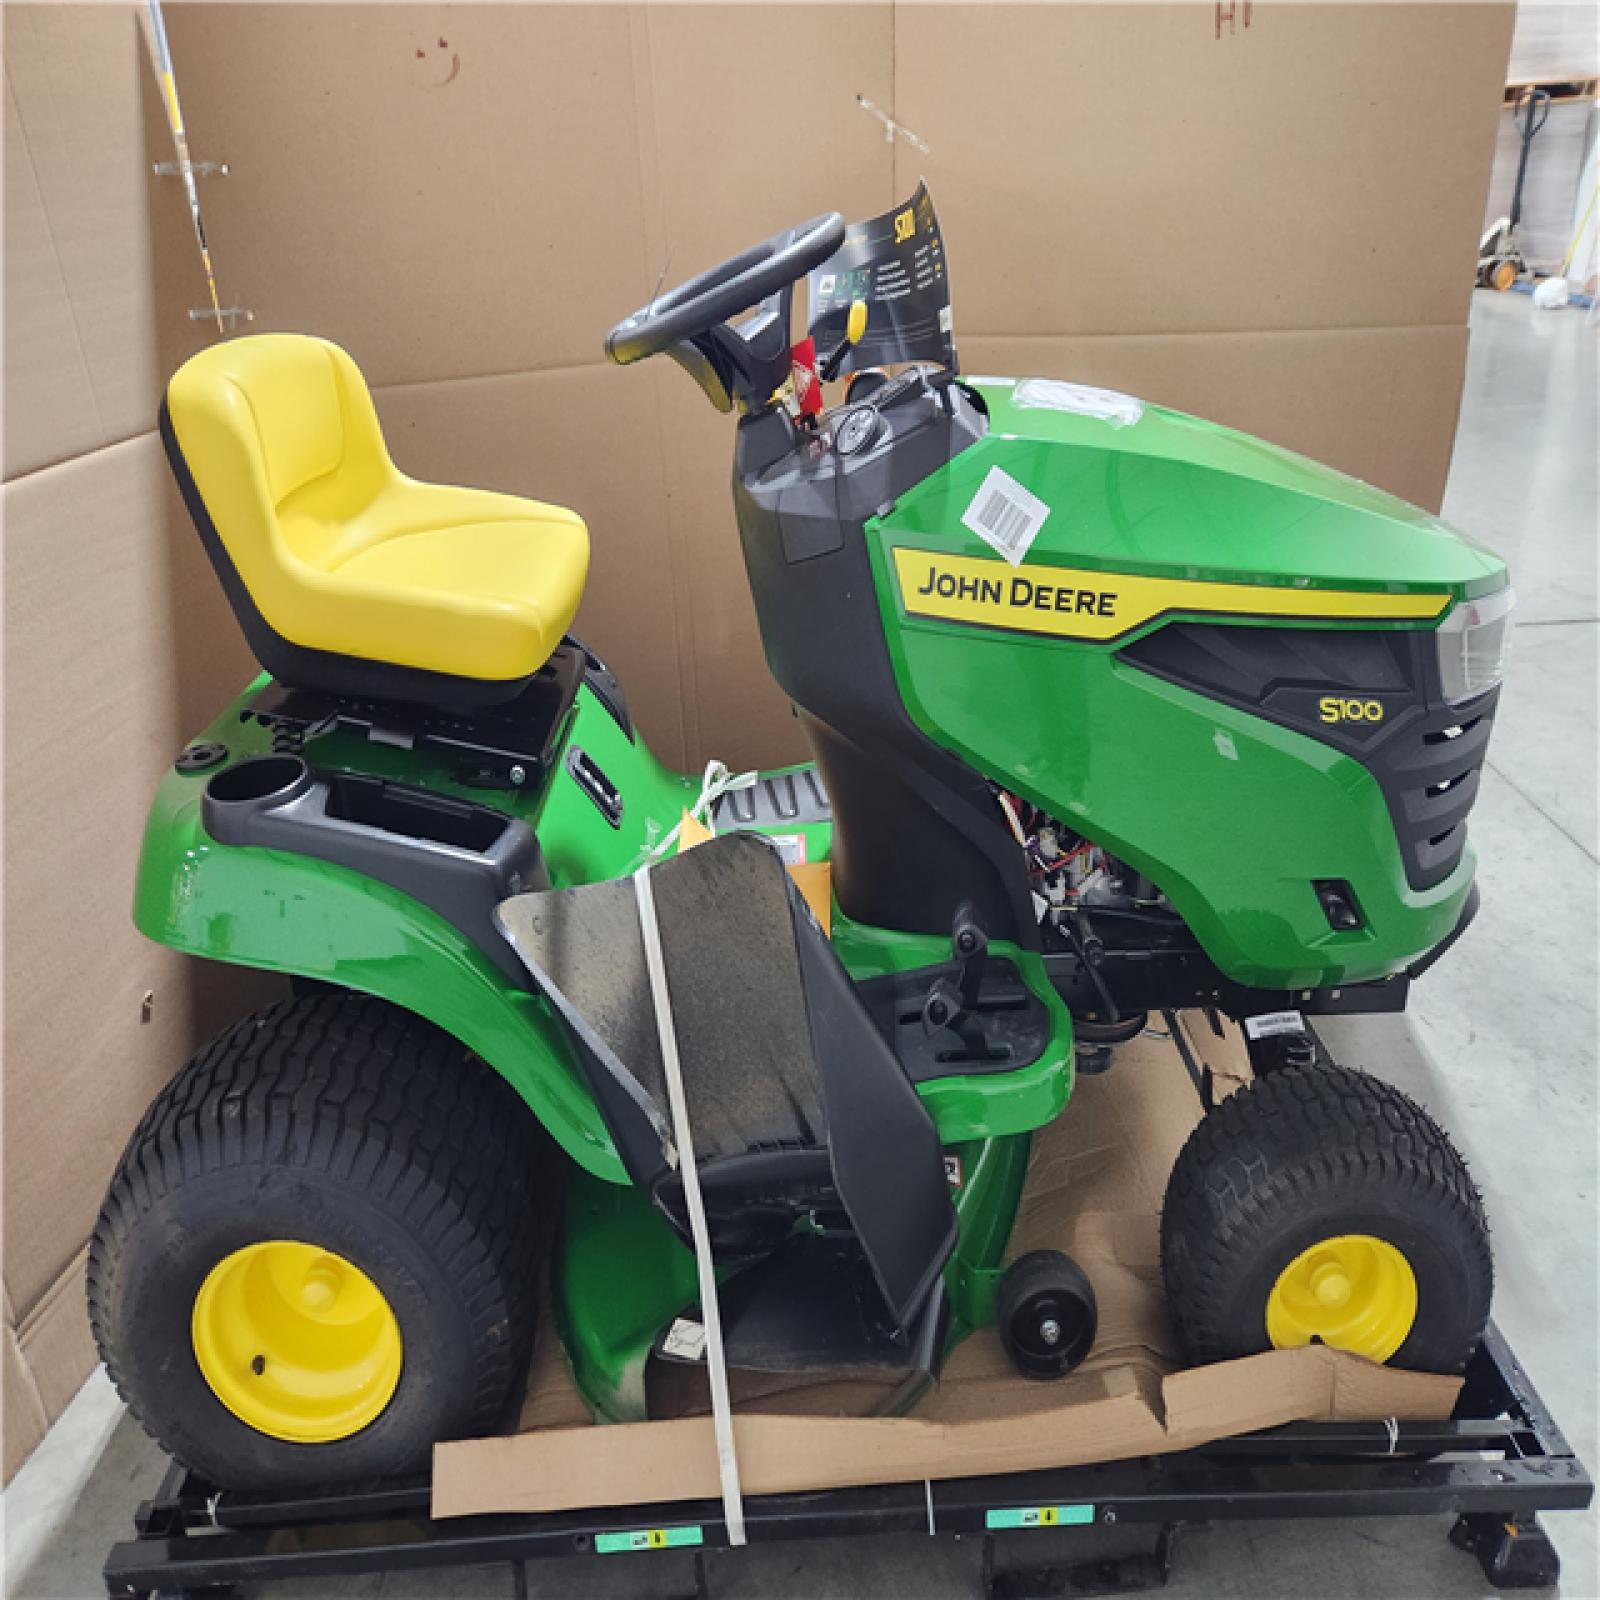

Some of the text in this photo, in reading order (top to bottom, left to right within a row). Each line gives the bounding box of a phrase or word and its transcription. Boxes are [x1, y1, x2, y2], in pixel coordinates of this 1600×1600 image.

[918, 566, 1118, 617] JOHN DEERE
[1319, 697, 1383, 723] S100
